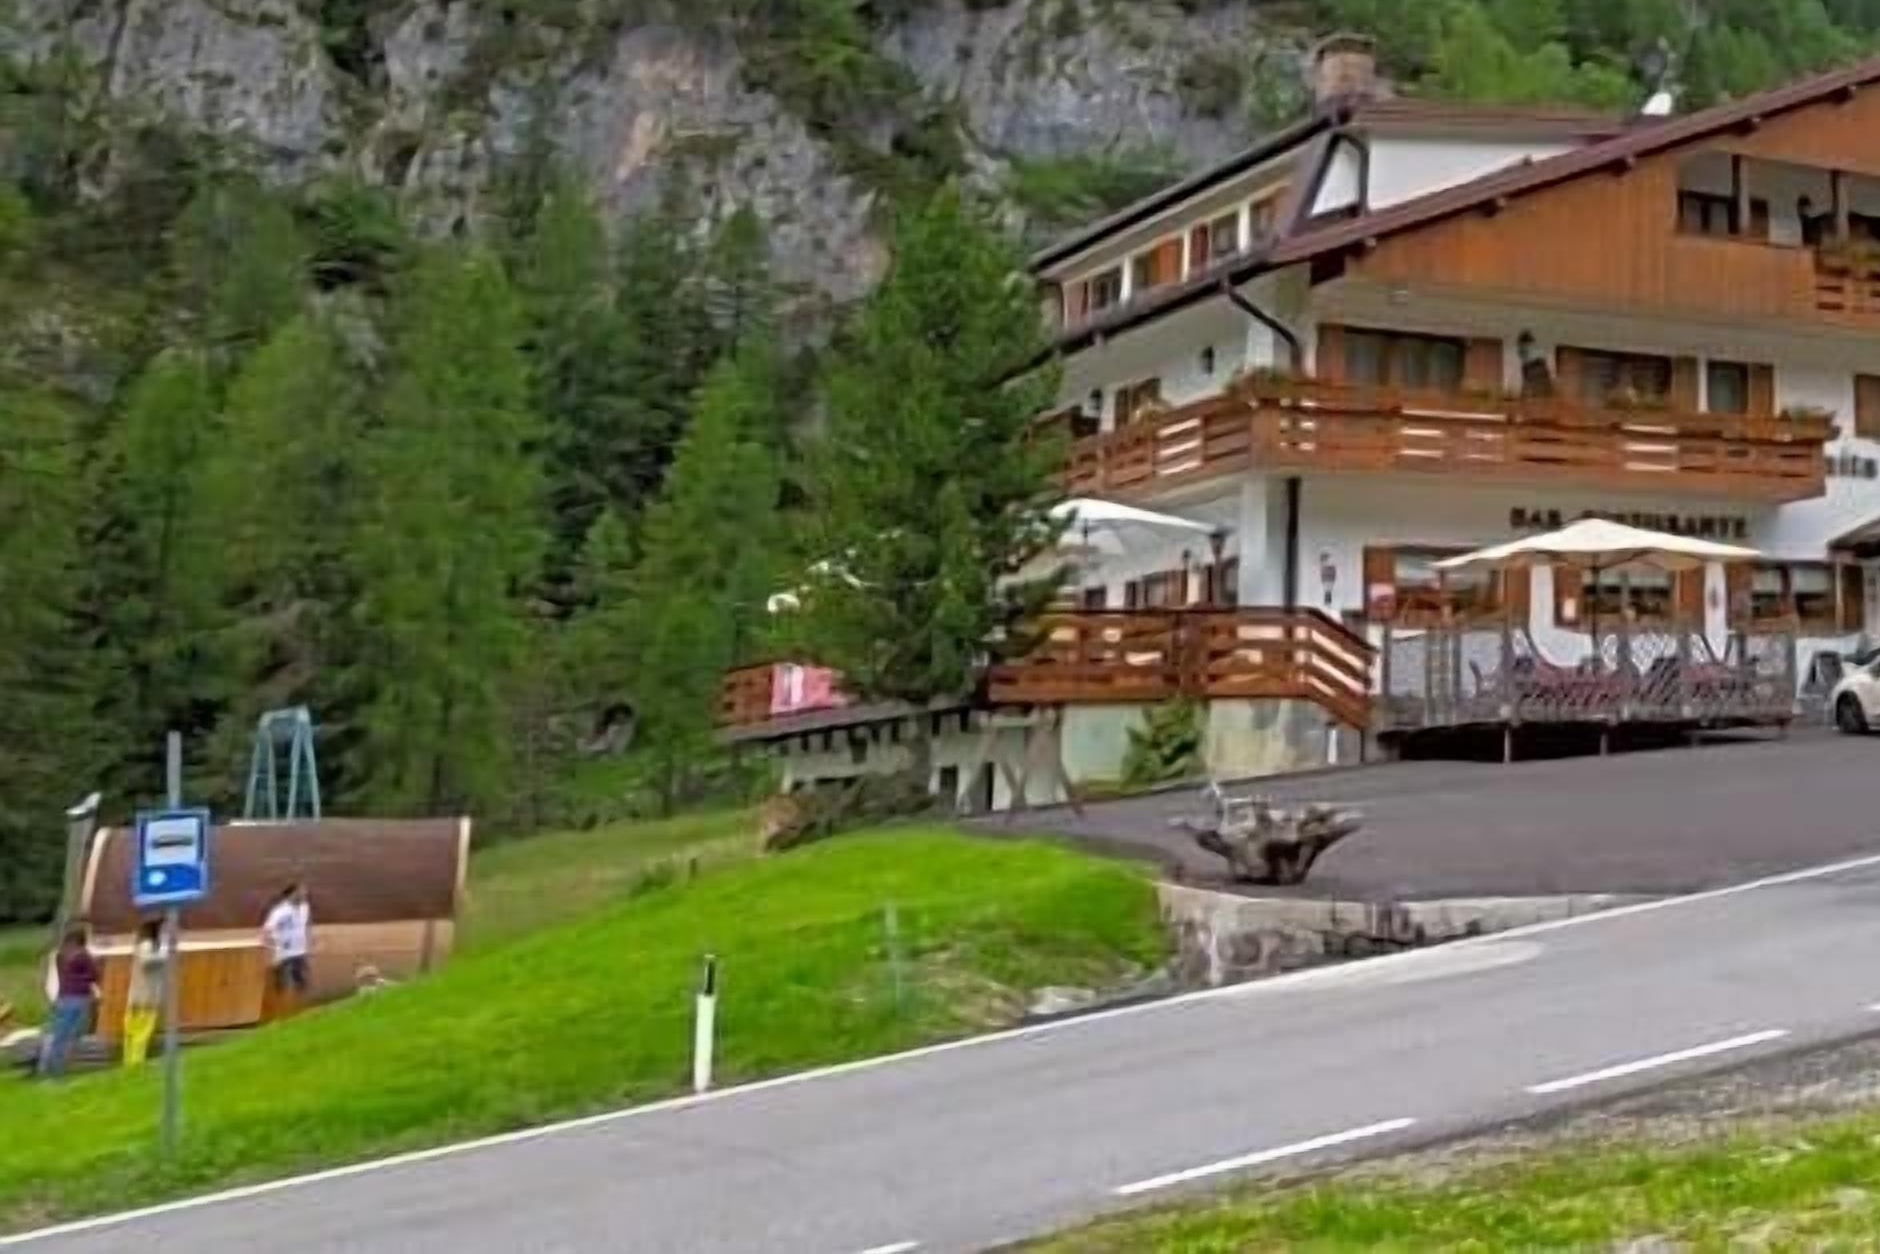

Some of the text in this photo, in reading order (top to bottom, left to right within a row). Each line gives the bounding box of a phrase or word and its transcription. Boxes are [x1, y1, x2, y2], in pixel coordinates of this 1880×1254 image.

[1823, 453, 1878, 480] aita
[1510, 506, 1747, 538] BAR STORANTE
